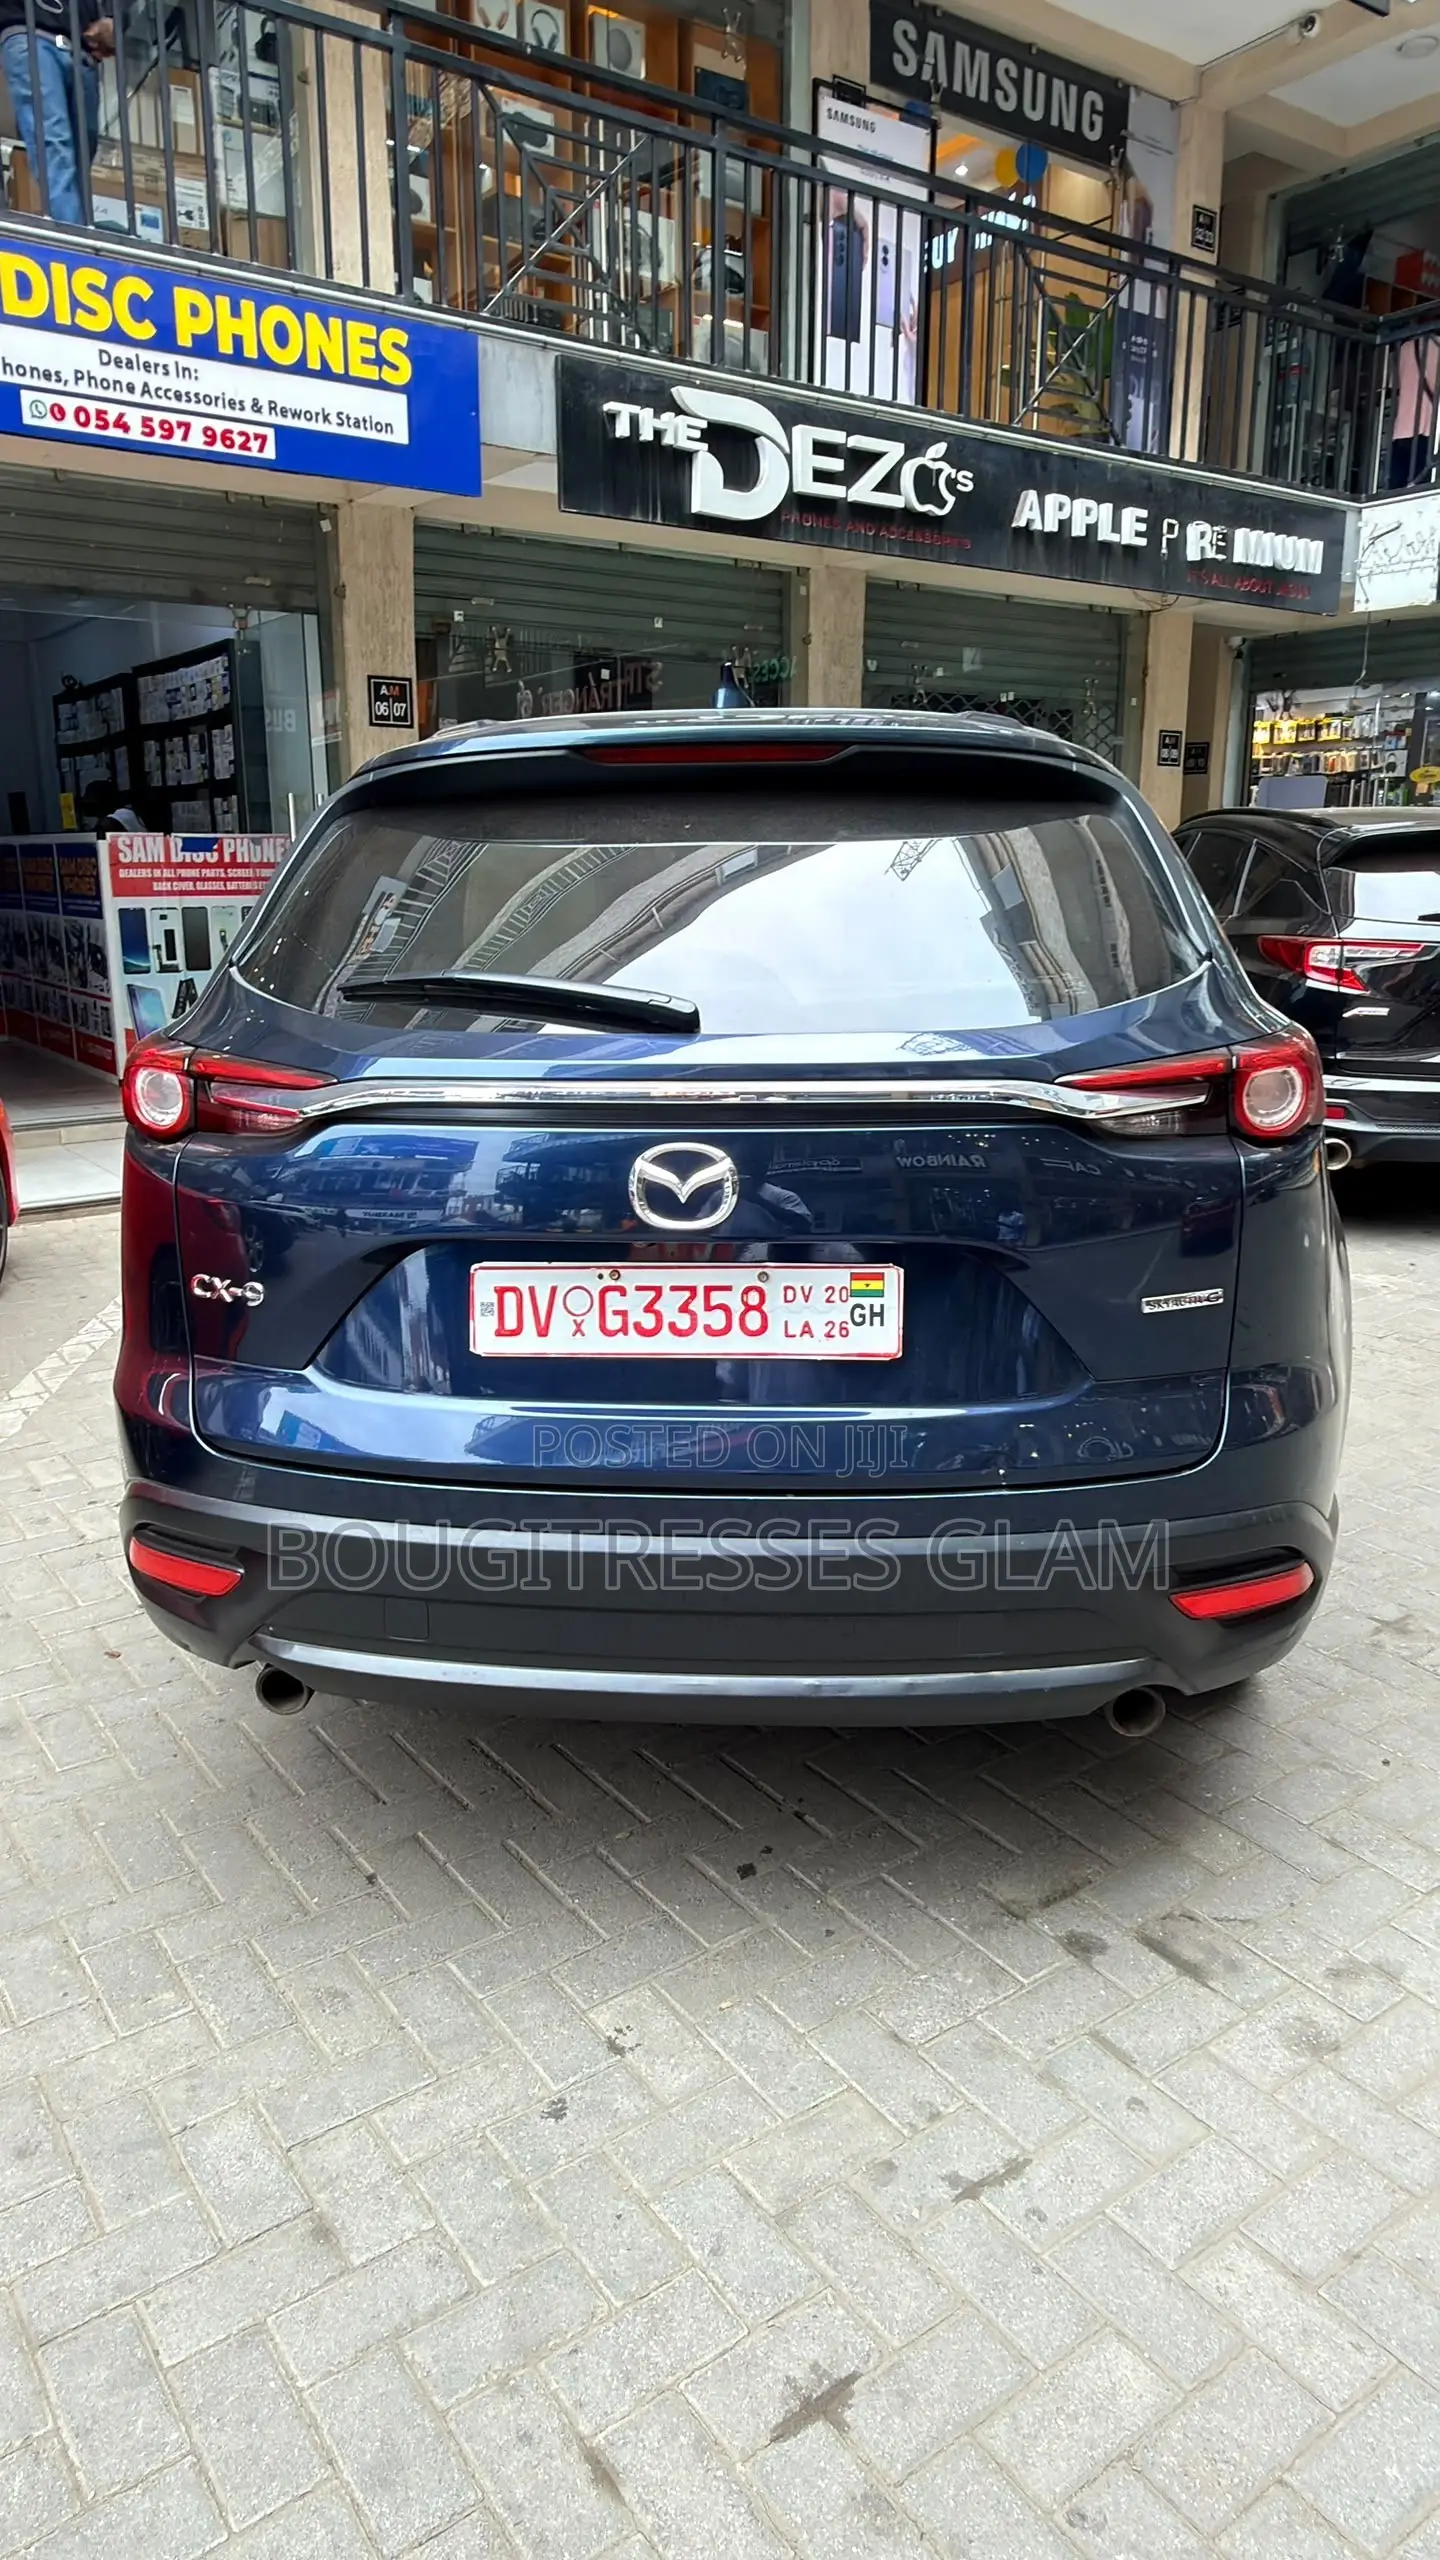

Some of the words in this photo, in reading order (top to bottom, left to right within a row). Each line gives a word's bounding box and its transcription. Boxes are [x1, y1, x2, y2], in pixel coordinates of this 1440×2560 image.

[892, 18, 1105, 142] SAMSUNG
[825, 106, 877, 133] SAMSUNG
[924, 226, 959, 273] UY
[0, 251, 157, 341] DISC
[173, 286, 412, 386] PHONES
[98, 349, 170, 377] Dealers
[175, 361, 199, 381] In:
[74, 369, 136, 394] Phone
[140, 381, 246, 412] Accessories
[250, 397, 263, 414] &
[267, 400, 332, 425] Rework
[336, 411, 394, 435] Station
[73, 405, 131, 434] 054
[140, 415, 192, 442] 597
[202, 425, 268, 454] 9627
[602, 400, 709, 452] THE
[846, 519, 876, 536] AND
[1011, 489, 1148, 547] APPLE
[375, 701, 389, 716] 06
[393, 702, 407, 717] 07
[117, 836, 164, 863] SAM
[191, 1273, 265, 1307] CX-9
[783, 1285, 813, 1303] DV
[824, 1285, 849, 1303] 20
[493, 1285, 558, 1338] DV
[598, 1285, 769, 1338] G3358
[850, 1303, 885, 1327] GH
[784, 1320, 814, 1338] LA
[824, 1320, 850, 1338] 26
